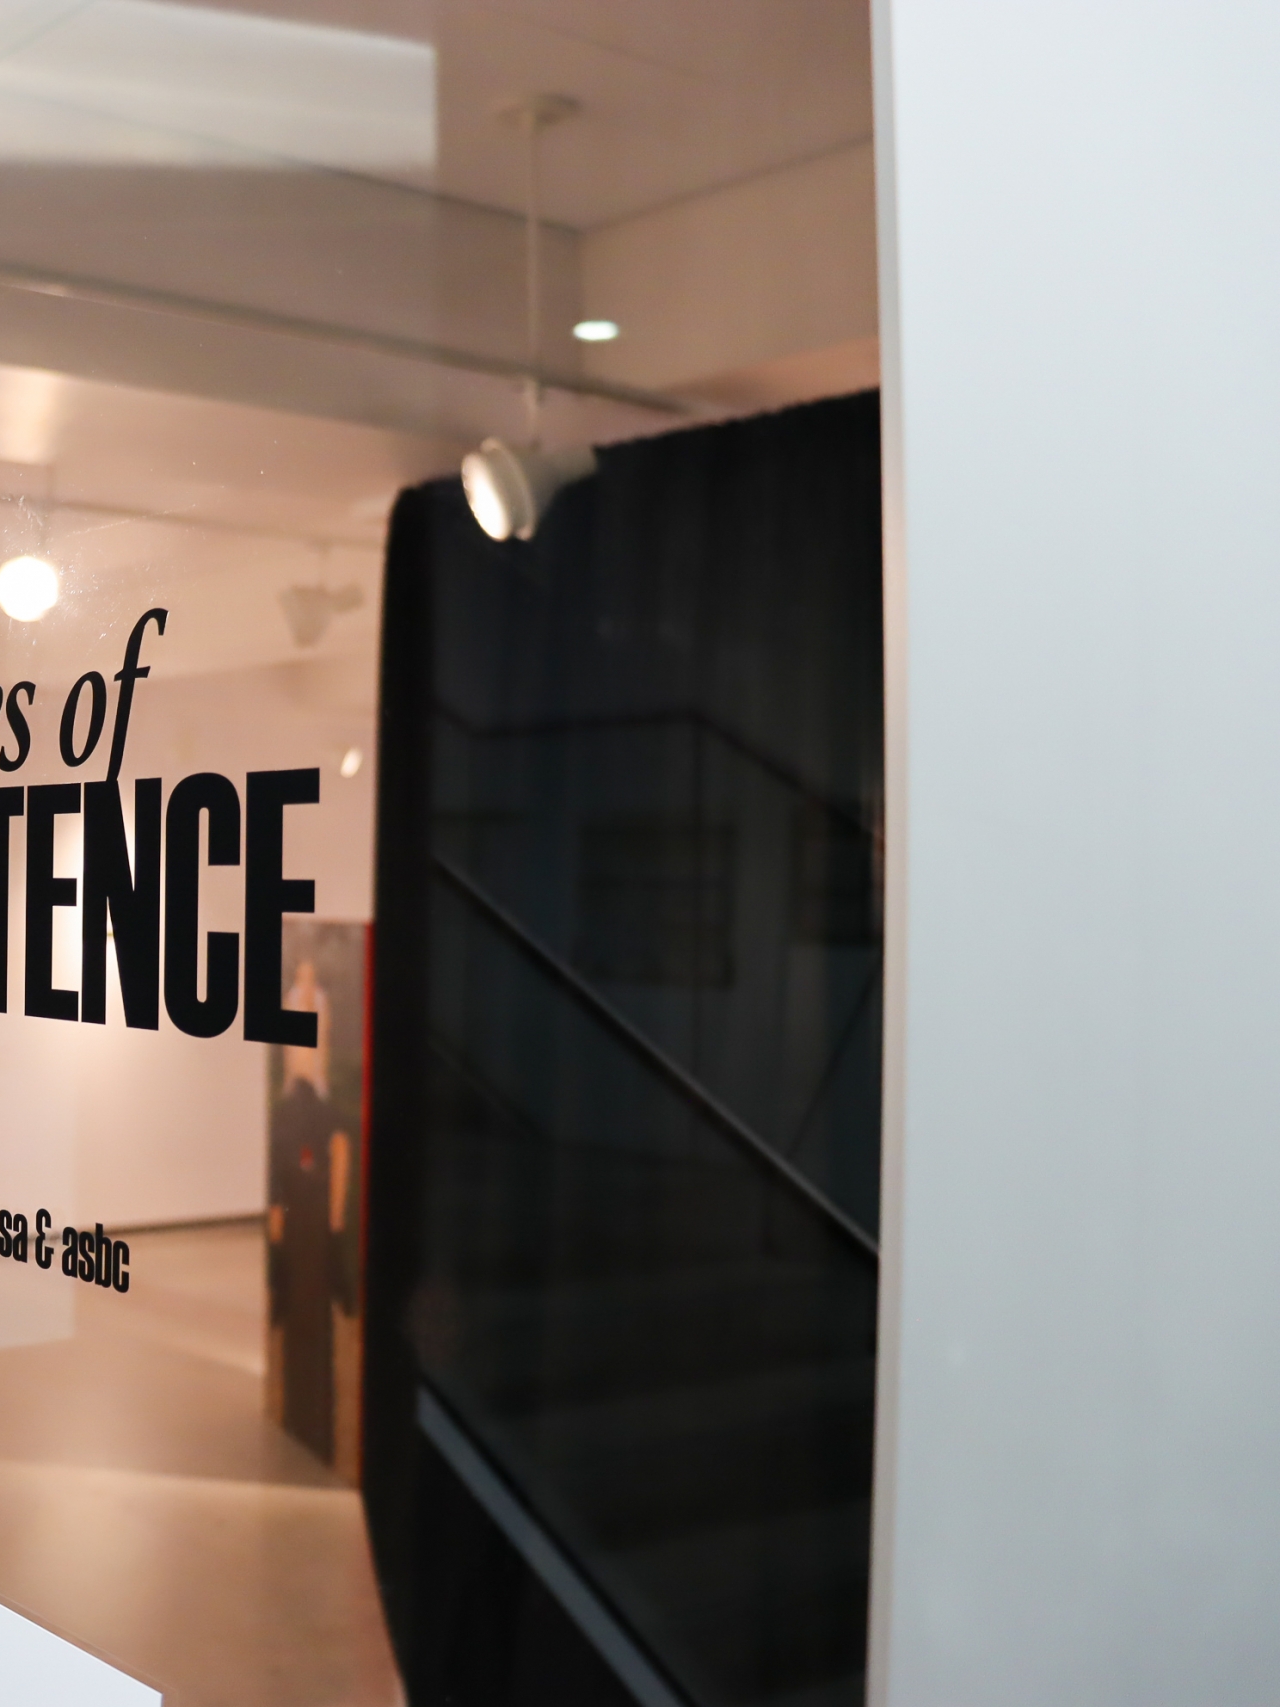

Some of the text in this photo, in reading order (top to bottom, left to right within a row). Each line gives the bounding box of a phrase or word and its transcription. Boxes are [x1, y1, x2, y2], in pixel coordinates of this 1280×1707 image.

[59, 607, 168, 785] of
[35, 1208, 54, 1269] &
[62, 1222, 130, 1293] asbc
